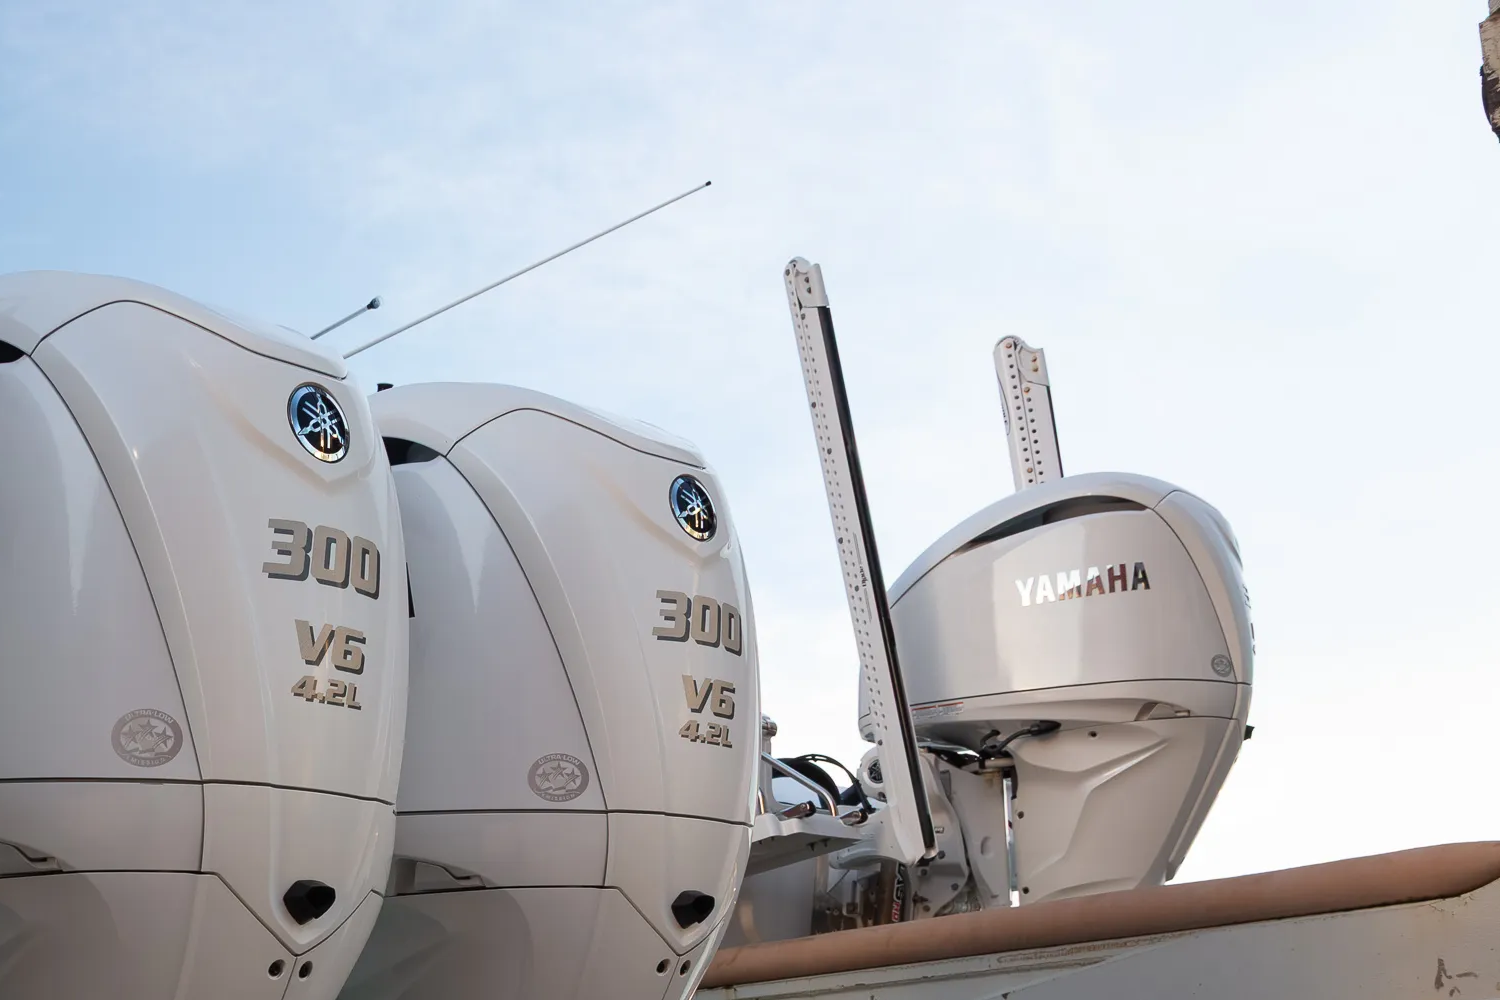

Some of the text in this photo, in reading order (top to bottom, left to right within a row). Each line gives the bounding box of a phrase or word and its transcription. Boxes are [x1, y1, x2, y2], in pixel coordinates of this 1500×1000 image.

[262, 518, 380, 600] 300
[1015, 562, 1151, 607] YAMAHA
[652, 590, 742, 656] 300
[294, 619, 366, 675] V6
[290, 675, 362, 710] 4.2L
[682, 674, 736, 720] V6
[678, 719, 733, 748] 4.2L
